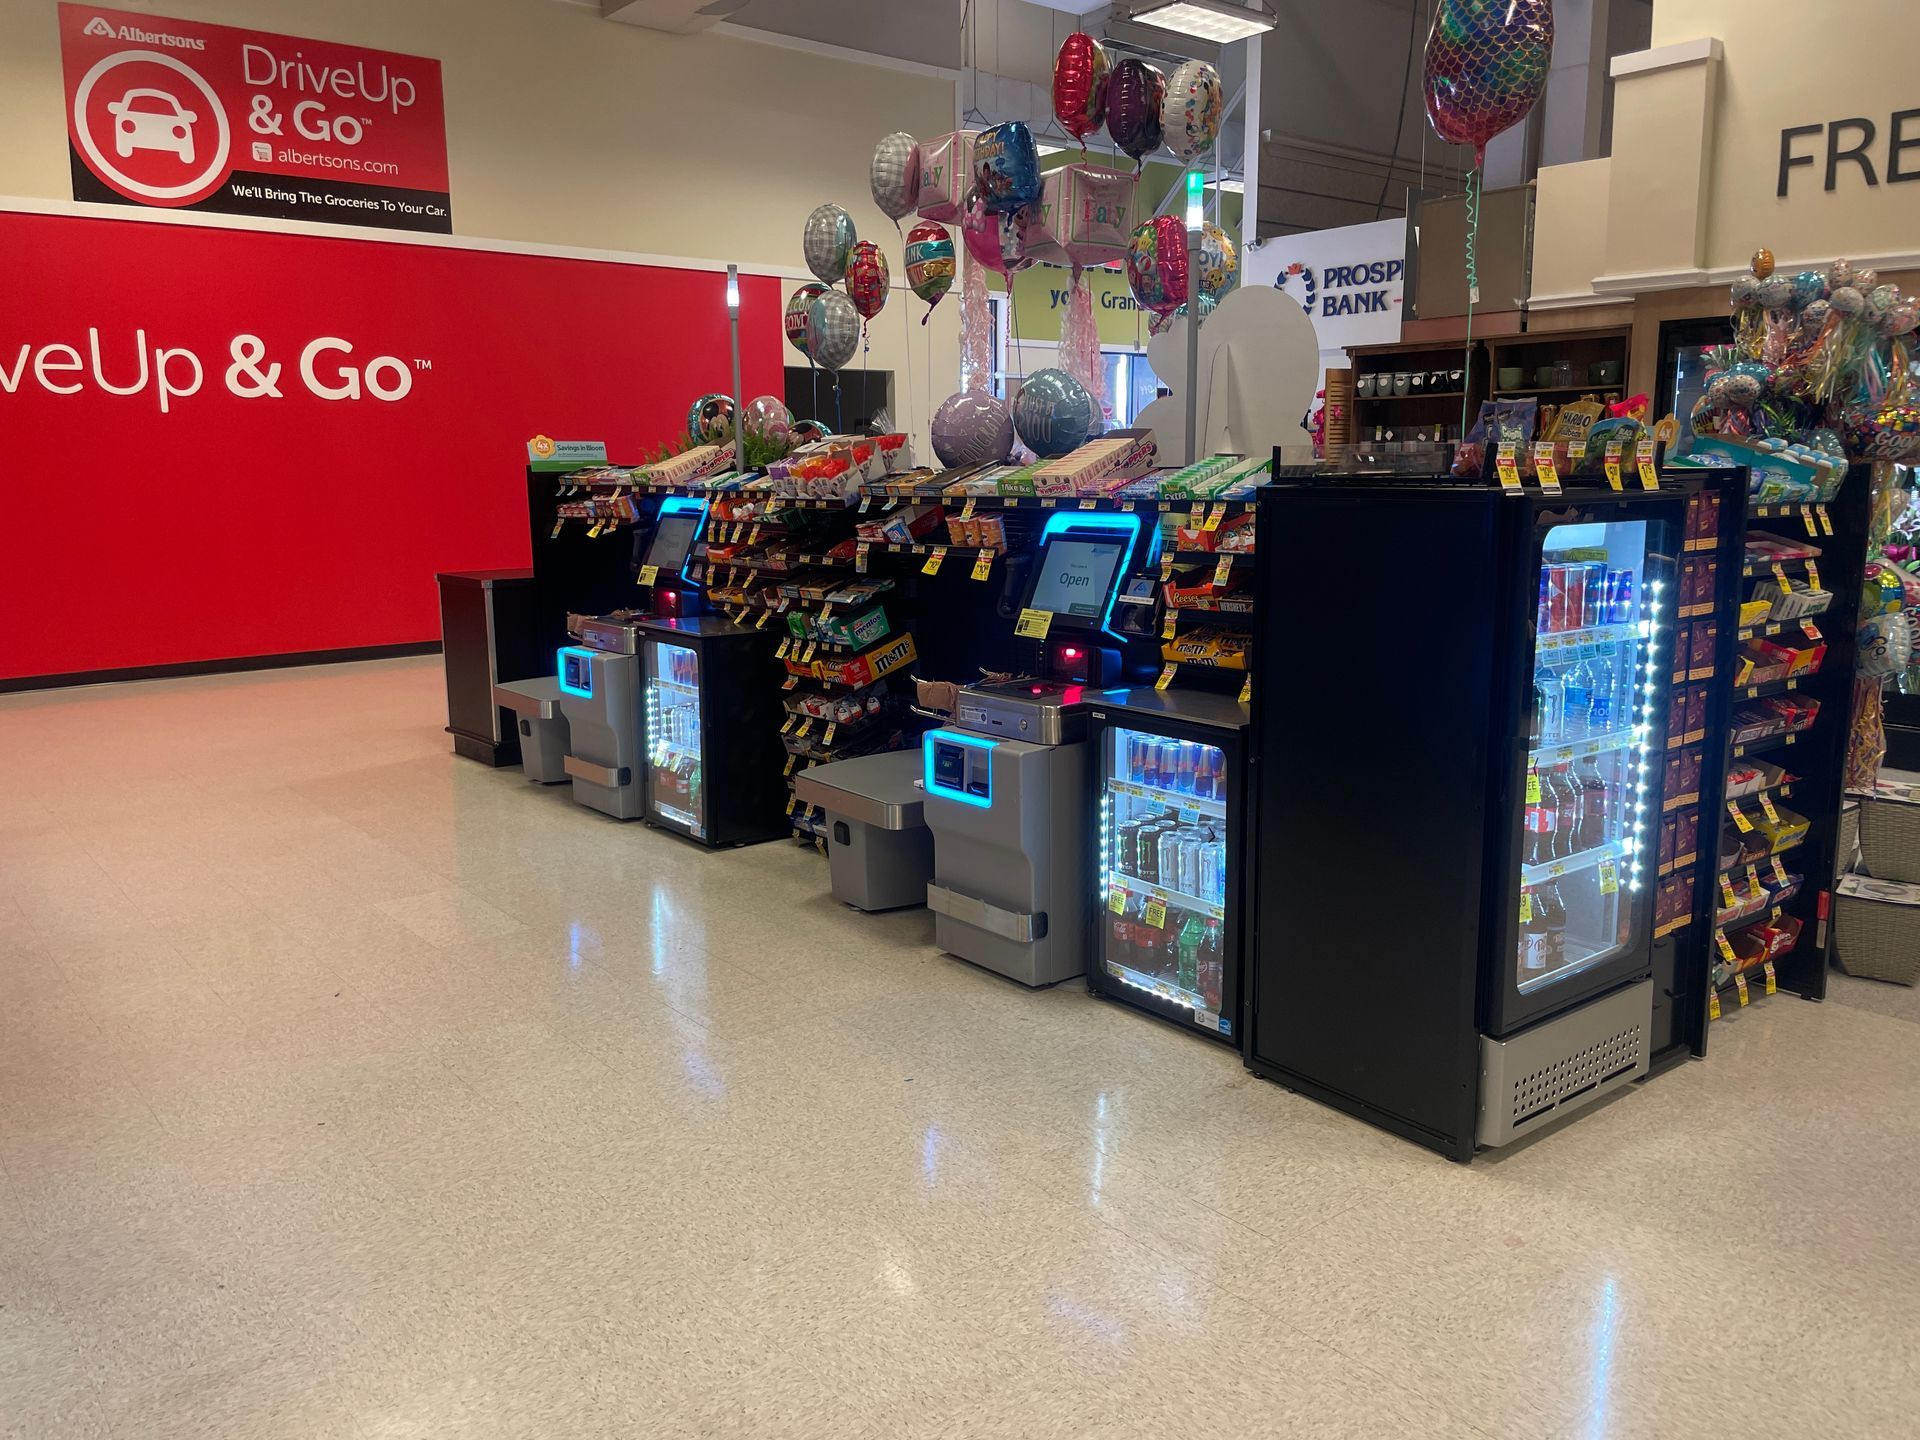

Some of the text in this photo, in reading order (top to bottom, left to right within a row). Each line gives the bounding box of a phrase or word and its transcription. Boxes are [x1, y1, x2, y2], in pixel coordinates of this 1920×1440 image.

[117, 26, 206, 51] Albertsons
[242, 44, 416, 114] DriveUp
[248, 94, 284, 137] &
[278, 148, 399, 176] albertsons.com
[1776, 108, 1920, 198] FRE
[231, 184, 448, 218] We'll Bring The Groceries To Your Car.
[1101, 291, 1145, 311] Gran
[1322, 290, 1389, 317] BANK
[224, 334, 284, 399] &
[1563, 411, 1592, 428] HARIBO
[557, 444, 580, 453] Savings
[696, 449, 735, 474] WHOPPERS
[1164, 490, 1188, 500] Extra
[1059, 572, 1090, 589] Open
[854, 613, 882, 637] mentos
[1111, 893, 1125, 906] FREE
[1149, 907, 1164, 920] FREE
